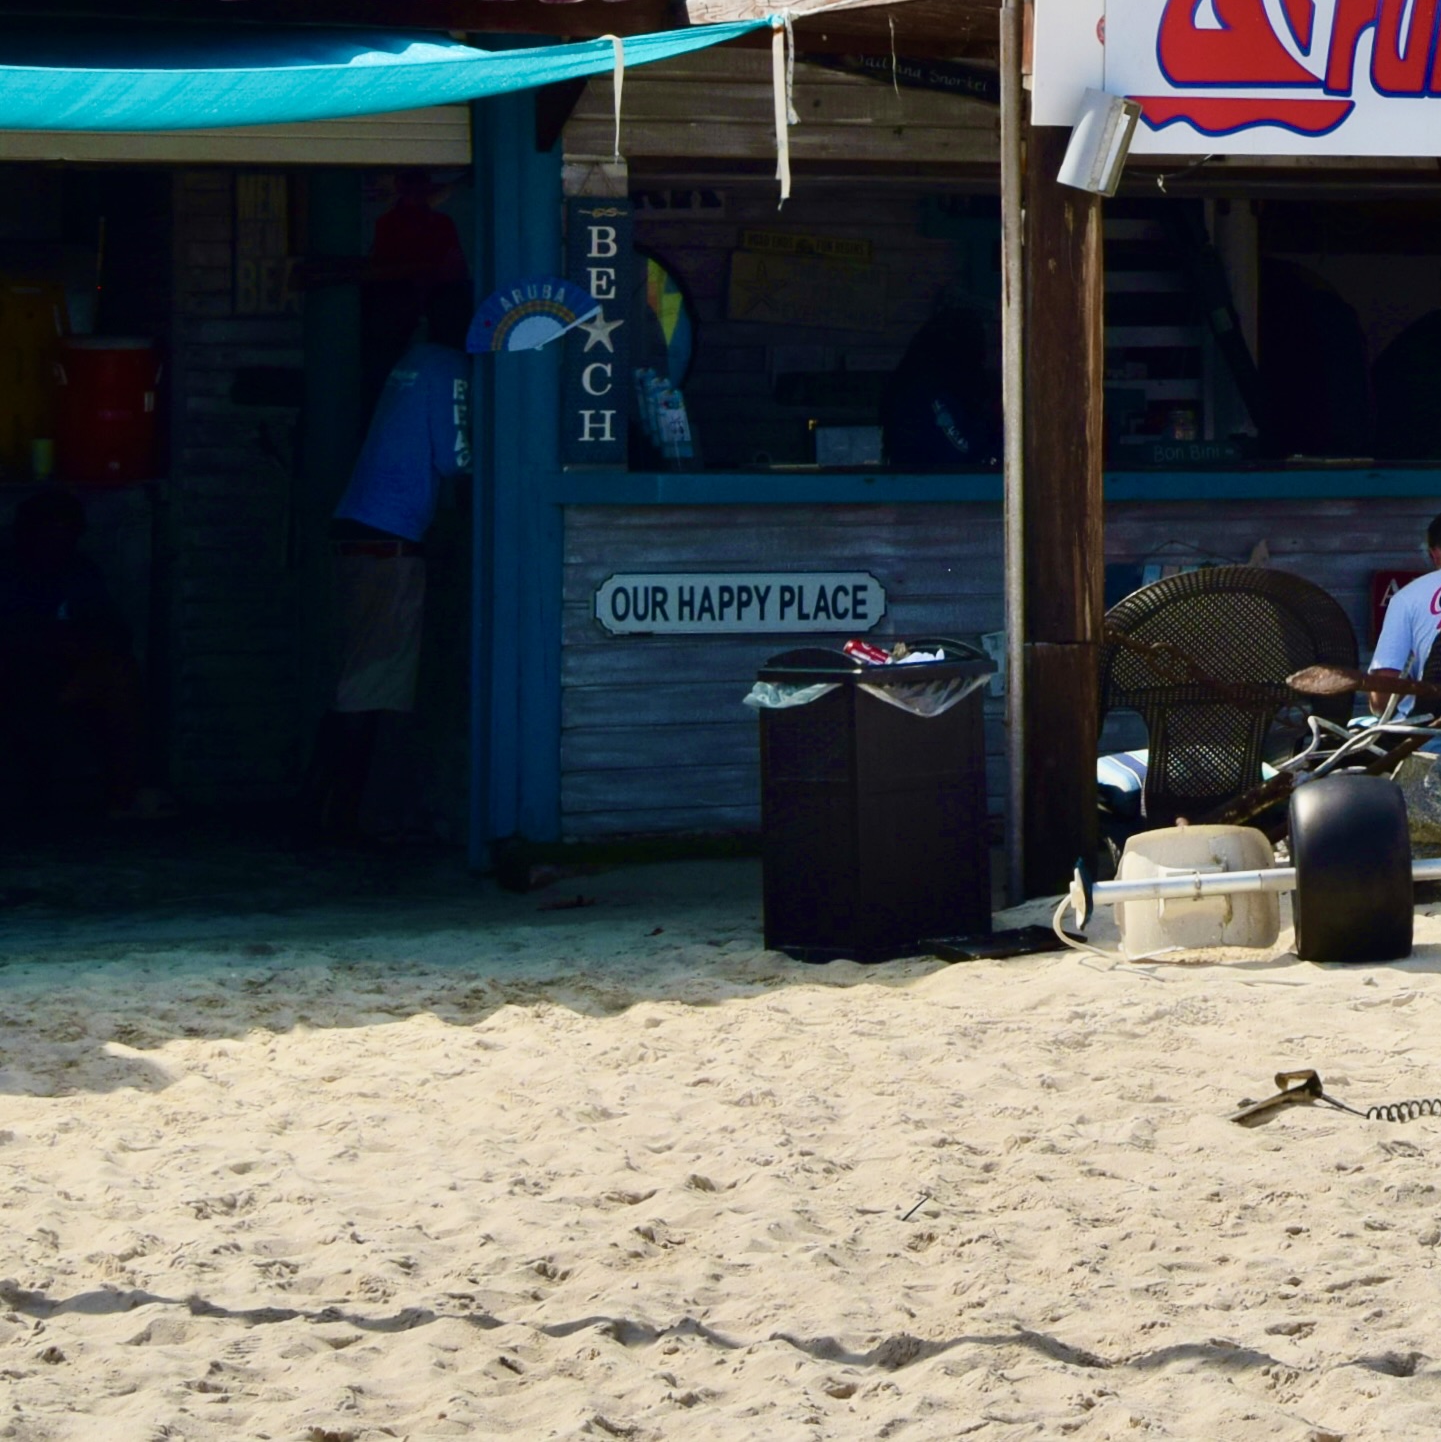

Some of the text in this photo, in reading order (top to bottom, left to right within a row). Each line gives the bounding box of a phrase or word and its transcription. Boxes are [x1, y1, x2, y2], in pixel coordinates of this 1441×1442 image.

[500, 284, 566, 314] ARUBA
[611, 585, 868, 622] OUR HAPPY PLACE
